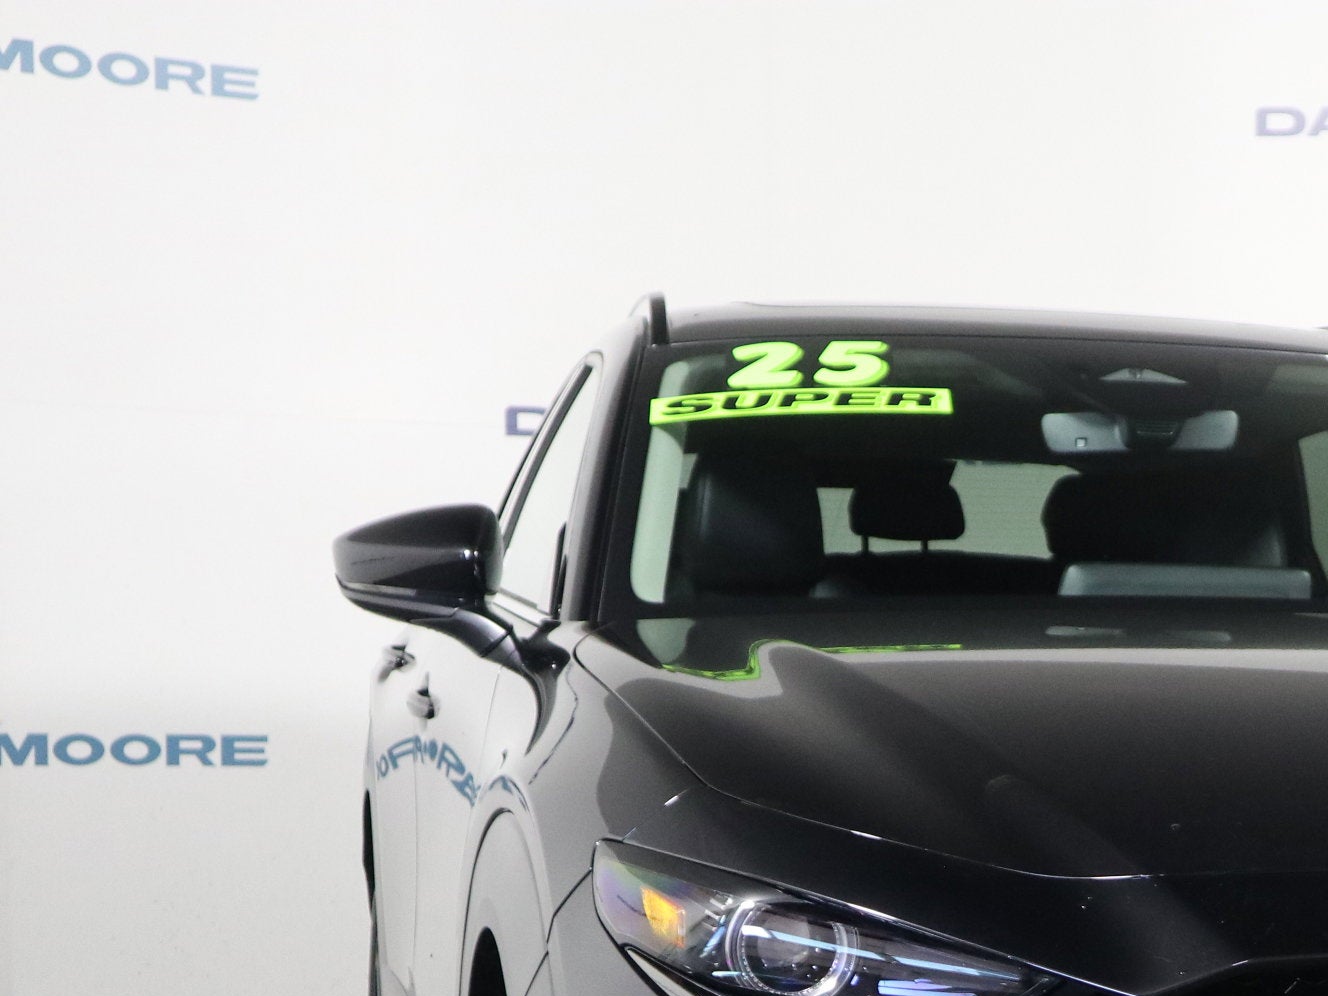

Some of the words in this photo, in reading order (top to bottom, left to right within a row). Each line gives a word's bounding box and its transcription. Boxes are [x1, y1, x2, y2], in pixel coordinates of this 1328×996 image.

[0, 37, 260, 101] MOORE
[726, 339, 890, 388] 25
[659, 388, 941, 418] SUPER
[0, 732, 269, 767] MOORE
